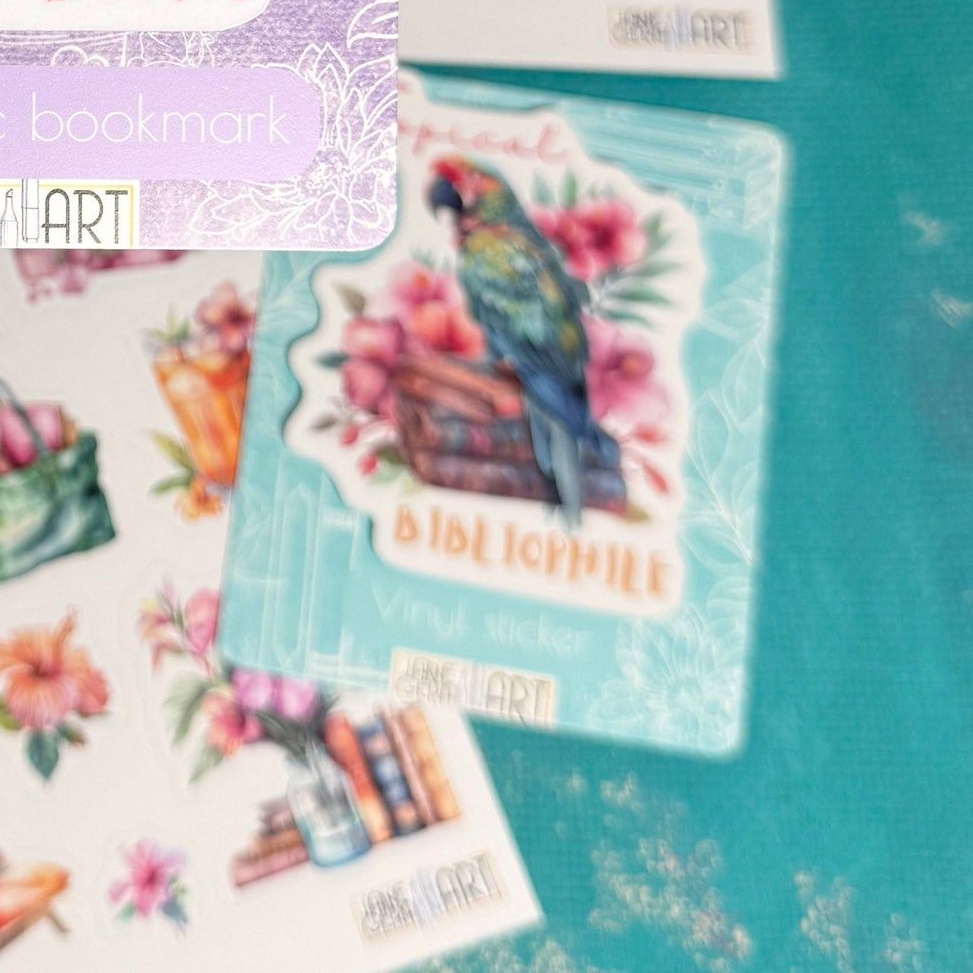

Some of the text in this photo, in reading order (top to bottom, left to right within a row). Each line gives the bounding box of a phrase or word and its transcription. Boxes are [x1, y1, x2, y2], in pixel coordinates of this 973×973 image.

[32, 92, 290, 144] bookmark
[41, 188, 129, 244] ART
[393, 503, 670, 595] BIBLIOPHILE
[485, 670, 553, 723] ART
